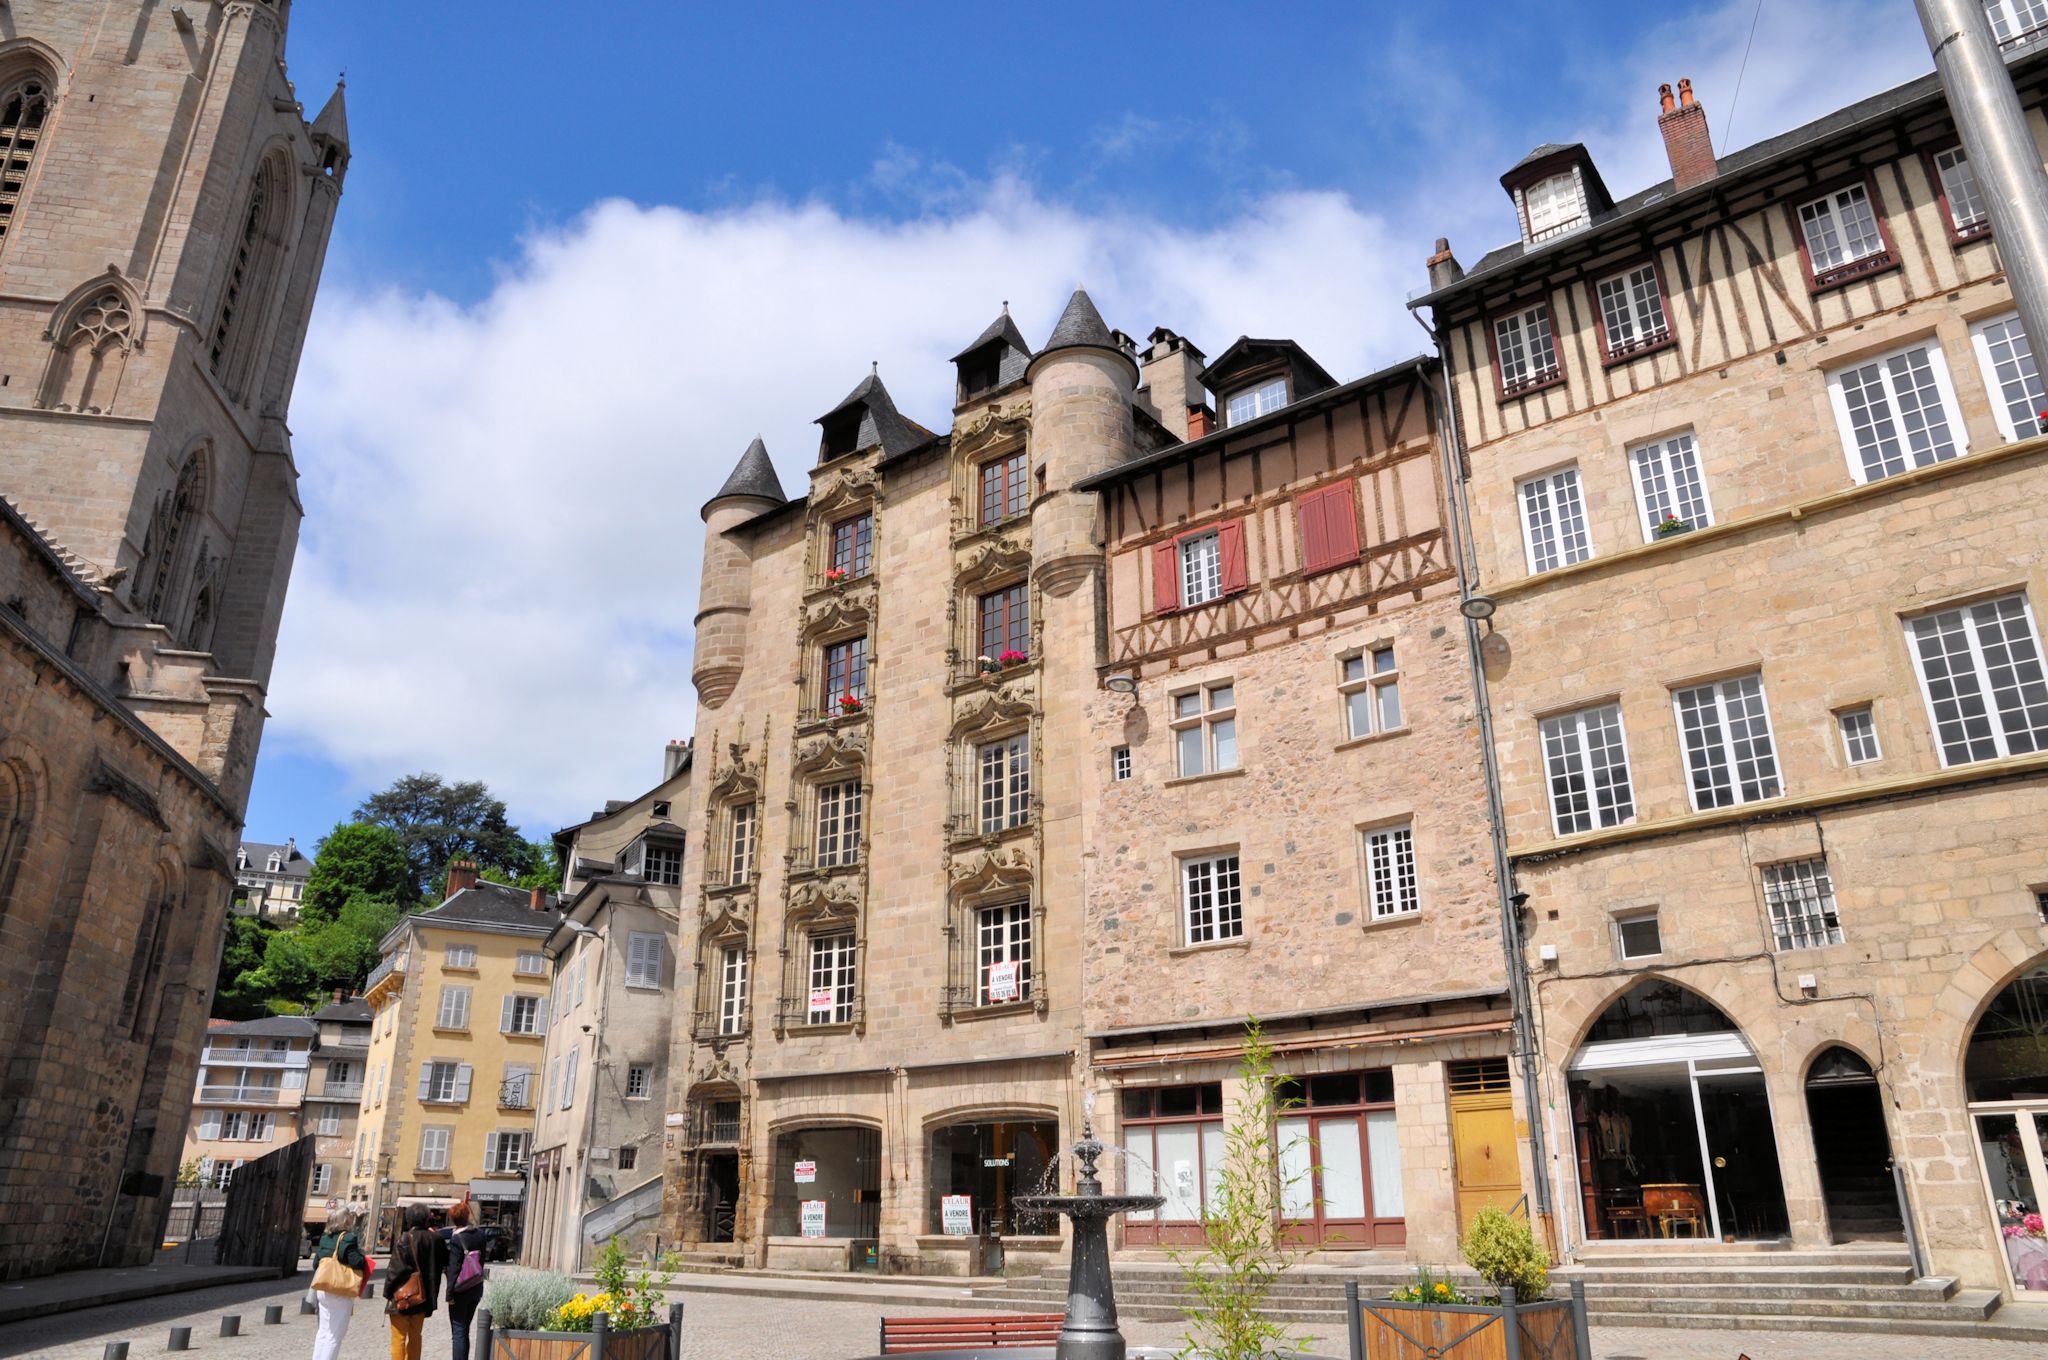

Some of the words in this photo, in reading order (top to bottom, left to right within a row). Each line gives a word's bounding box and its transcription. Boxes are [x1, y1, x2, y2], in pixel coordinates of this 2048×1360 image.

[996, 974, 1013, 982] VENDRE
[984, 1159, 1009, 1167] SOLUTIONS
[807, 1213, 823, 1221] VENDRE
[950, 1209, 968, 1217] VENDRE
